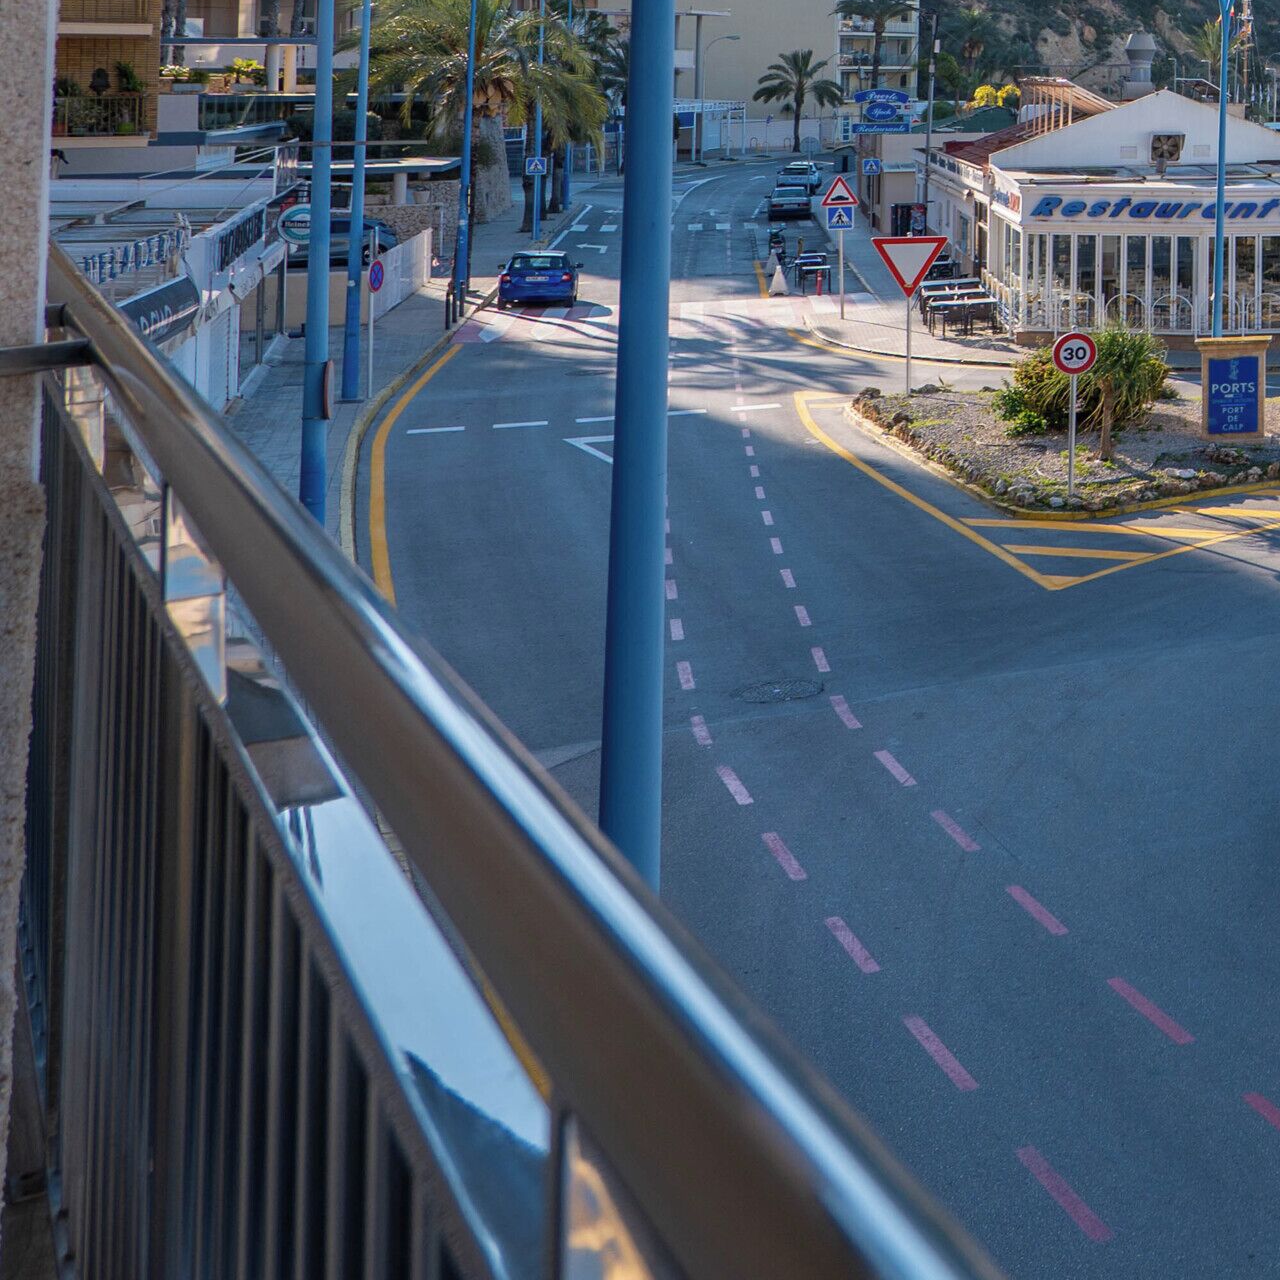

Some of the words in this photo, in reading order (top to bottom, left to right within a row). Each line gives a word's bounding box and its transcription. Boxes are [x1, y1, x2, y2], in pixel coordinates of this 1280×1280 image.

[1063, 346, 1087, 361] 30
[1211, 382, 1255, 394] PORTS
[1222, 406, 1244, 414] PORT
[1227, 415, 1239, 423] DE
[1222, 423, 1244, 431] CALP
